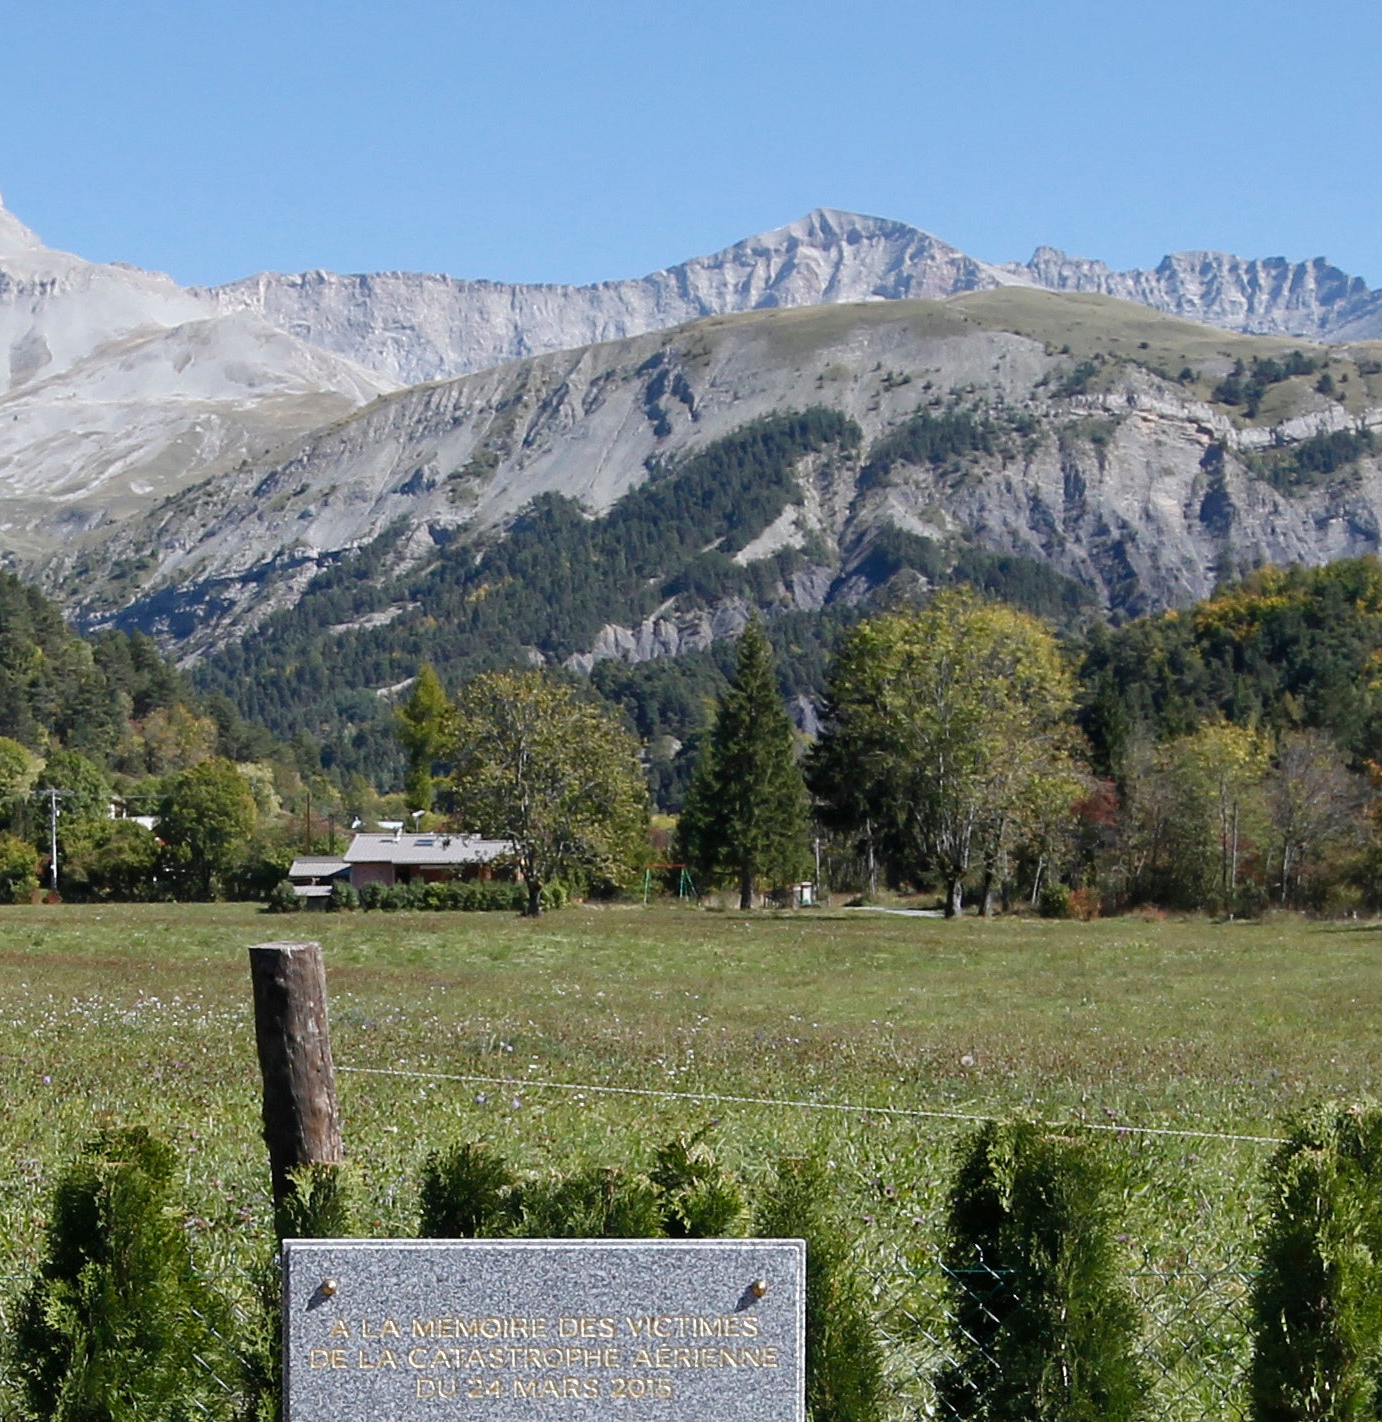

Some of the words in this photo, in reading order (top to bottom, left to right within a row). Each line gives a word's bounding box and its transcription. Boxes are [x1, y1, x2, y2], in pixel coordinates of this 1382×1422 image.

[361, 1316, 402, 1339] LA
[411, 1311, 549, 1339] MÉMOIRE
[559, 1315, 617, 1338] DES
[625, 1314, 762, 1338] VICTIMES
[309, 1347, 349, 1369] DE
[359, 1347, 398, 1369] LA
[408, 1347, 622, 1369] CATASTROPHE
[632, 1343, 782, 1368] AÉRIENNE
[415, 1378, 458, 1399] DU
[467, 1378, 503, 1399] 24
[513, 1378, 601, 1399] MARS
[610, 1377, 675, 1399] 2015
